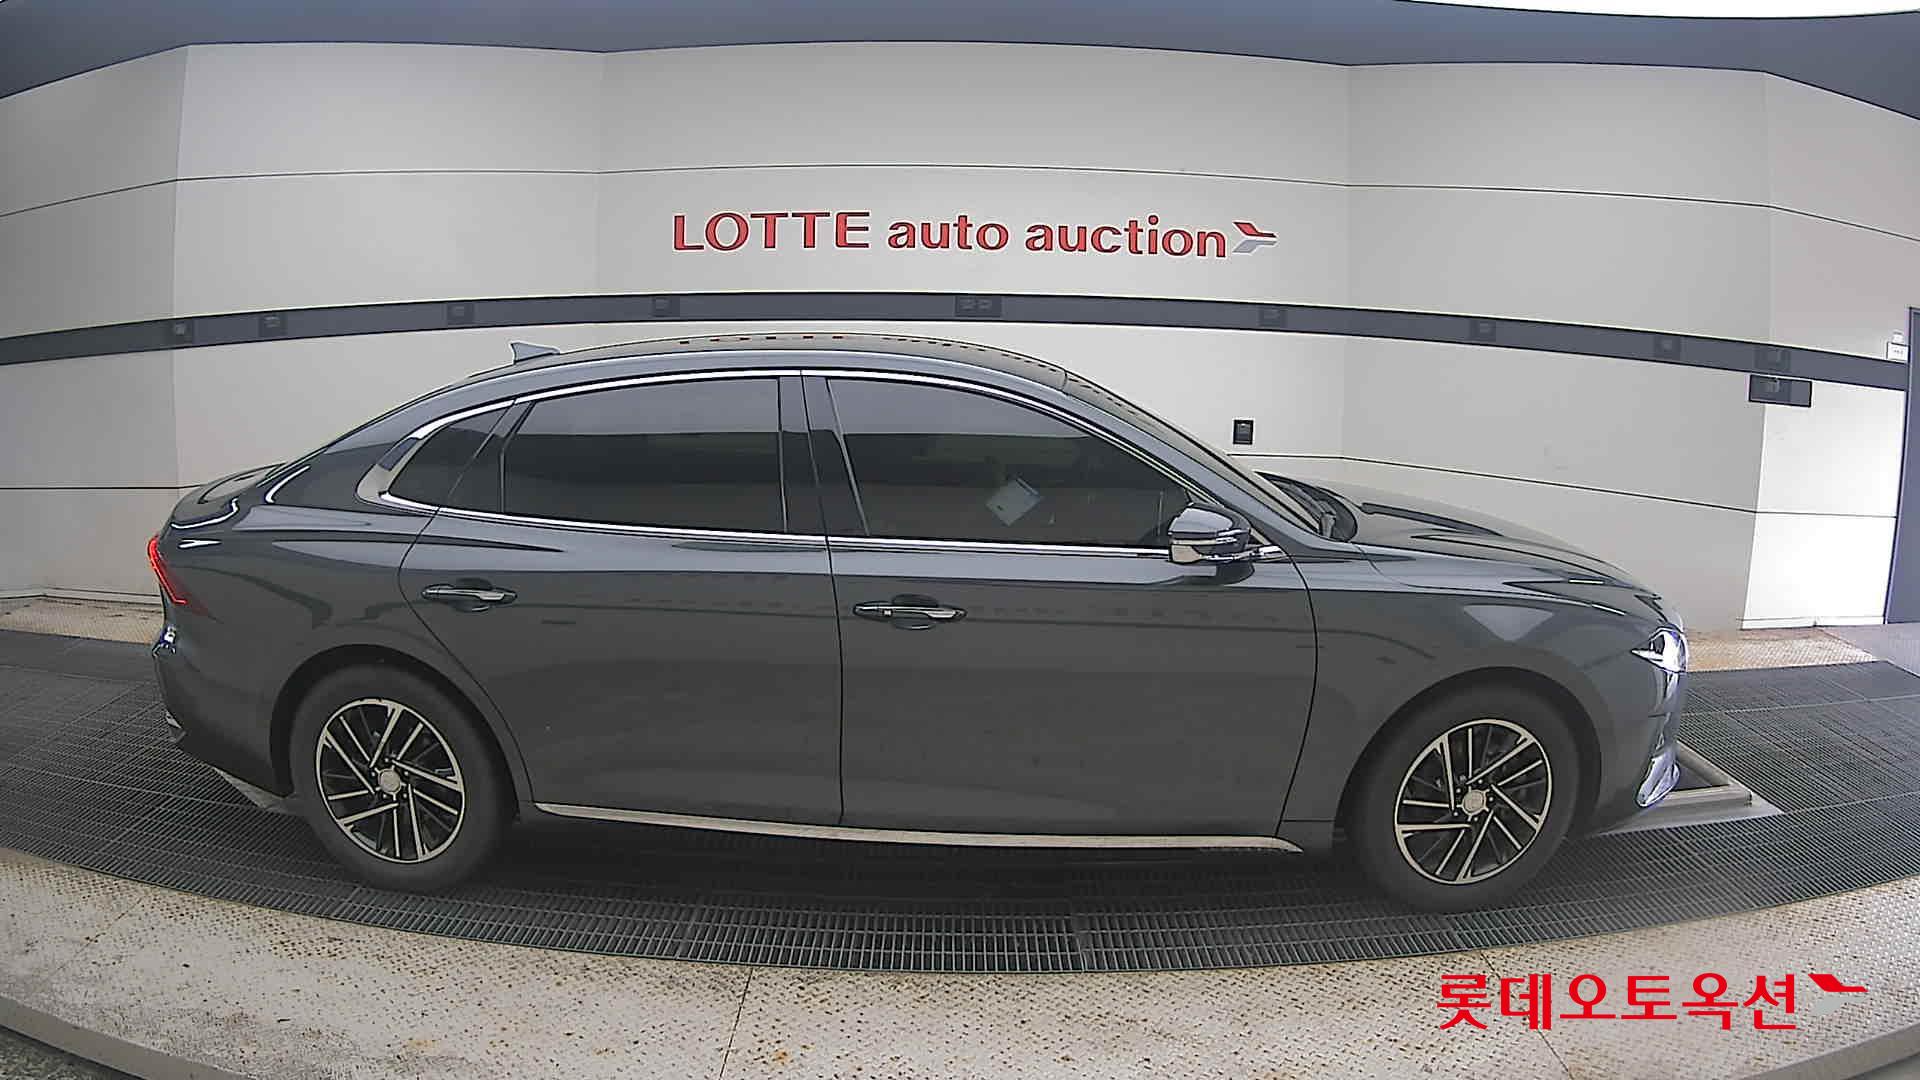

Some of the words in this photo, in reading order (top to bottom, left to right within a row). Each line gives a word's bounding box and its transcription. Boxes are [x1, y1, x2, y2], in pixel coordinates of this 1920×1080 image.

[673, 212, 870, 252] LOTTE
[887, 215, 1009, 250] auto
[1025, 215, 1227, 258] auction
